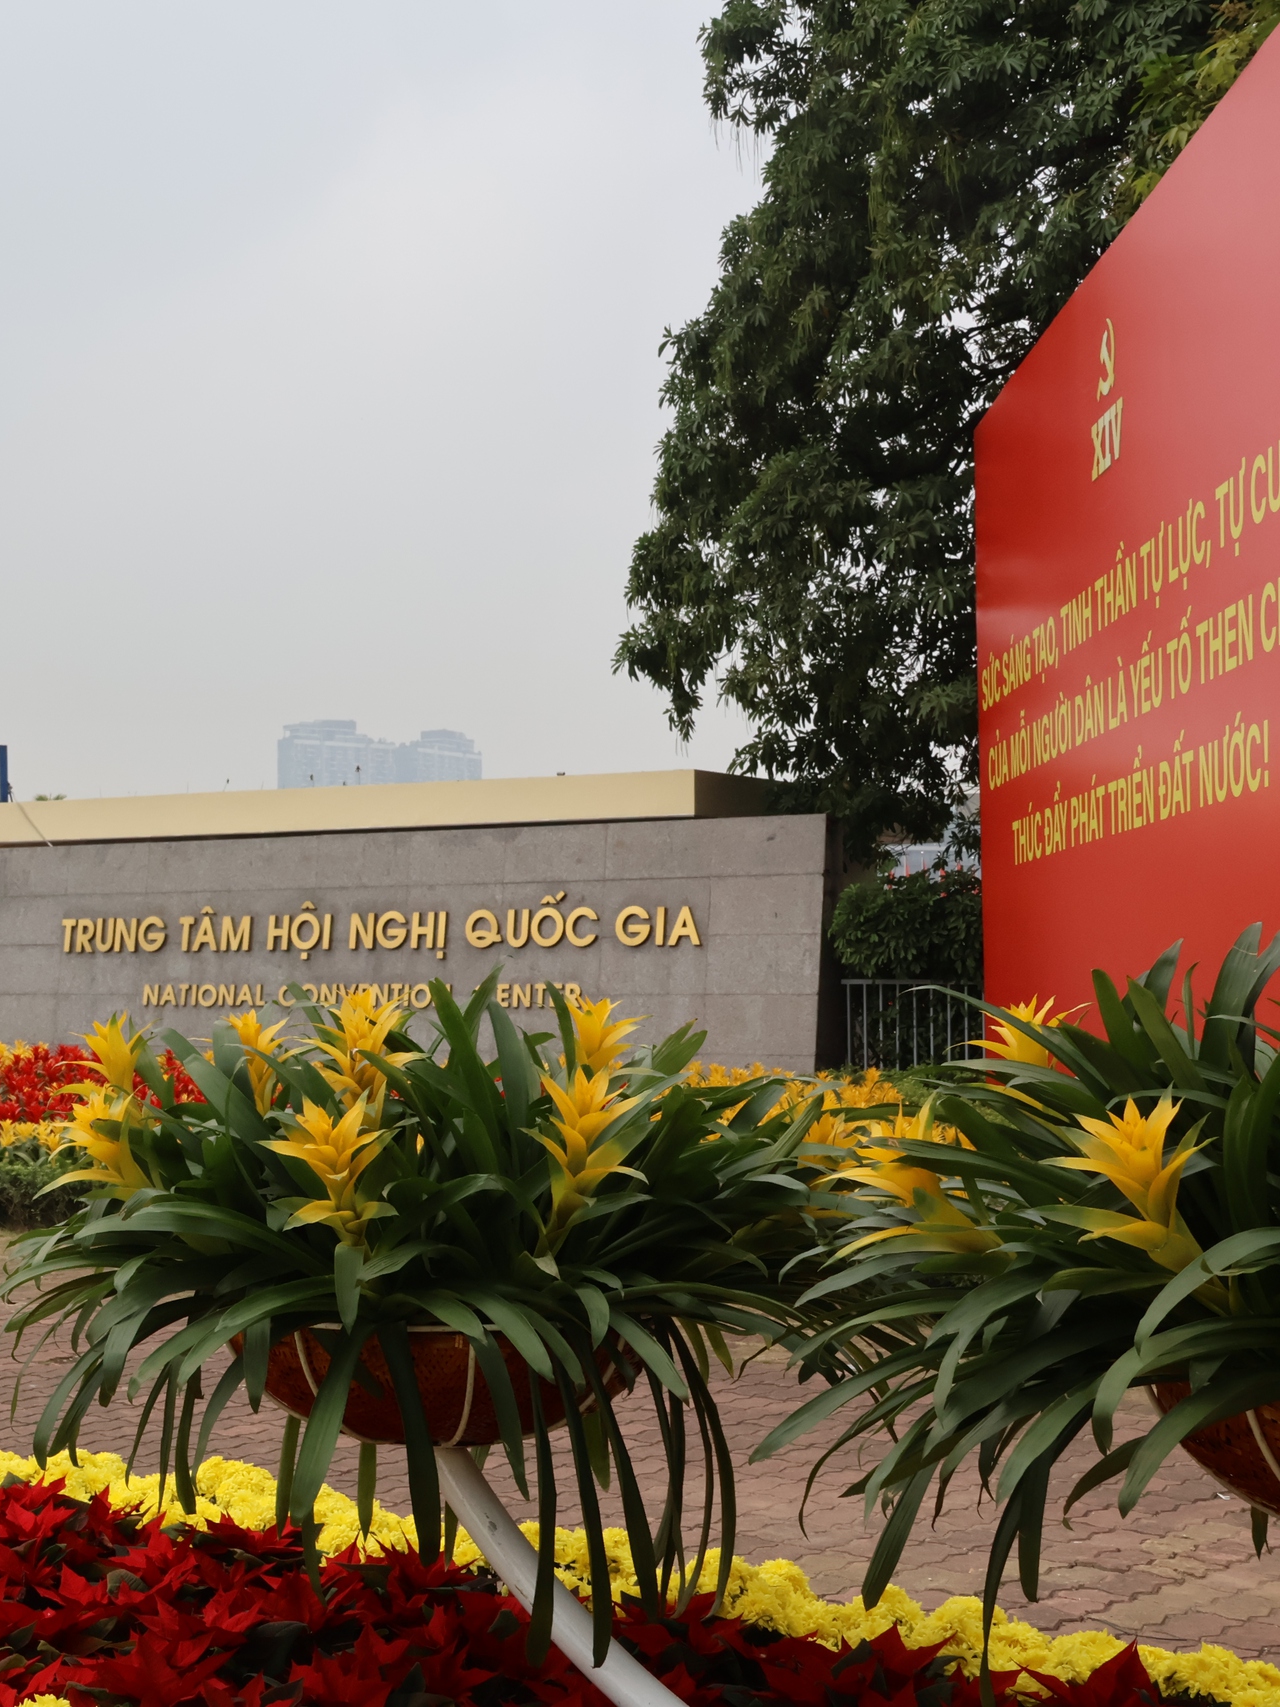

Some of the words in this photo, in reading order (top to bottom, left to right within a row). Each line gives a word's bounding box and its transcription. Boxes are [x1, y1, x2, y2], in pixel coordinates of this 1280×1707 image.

[1091, 396, 1123, 482] XIV
[982, 651, 1001, 712] SỨC
[1002, 634, 1031, 697] SÁNG
[1032, 616, 1059, 684] TẠO,
[1060, 586, 1092, 655] TINH
[1094, 541, 1137, 632] THẦN
[1139, 520, 1164, 609] TỰ
[1167, 498, 1211, 591] LỰC,
[1215, 456, 1246, 557] TỰ
[988, 729, 1009, 791] CỦA
[1010, 709, 1031, 780] MỖI
[1033, 691, 1072, 768] NGƯỜI
[1074, 674, 1105, 747] DÂN
[1108, 655, 1128, 731] LÀ
[1129, 630, 1163, 718] YẾU
[1166, 605, 1192, 700] TỐ
[1195, 593, 1253, 685] THEN
[1012, 801, 1042, 866] THÚC
[1044, 780, 1068, 856] ĐẨY
[1070, 773, 1106, 848] PHÁT
[1107, 744, 1155, 835] TRIỂN
[1158, 729, 1194, 820] ĐẤT
[1198, 710, 1269, 808] NƯỚC!
[61, 915, 166, 953] TRUNG
[179, 905, 252, 952] TÂM
[266, 900, 333, 960] HỘI
[348, 910, 448, 960] NGHỊ
[465, 890, 598, 949] QUỐC
[615, 905, 701, 947] GIA
[142, 983, 265, 1007] NATIONAL
